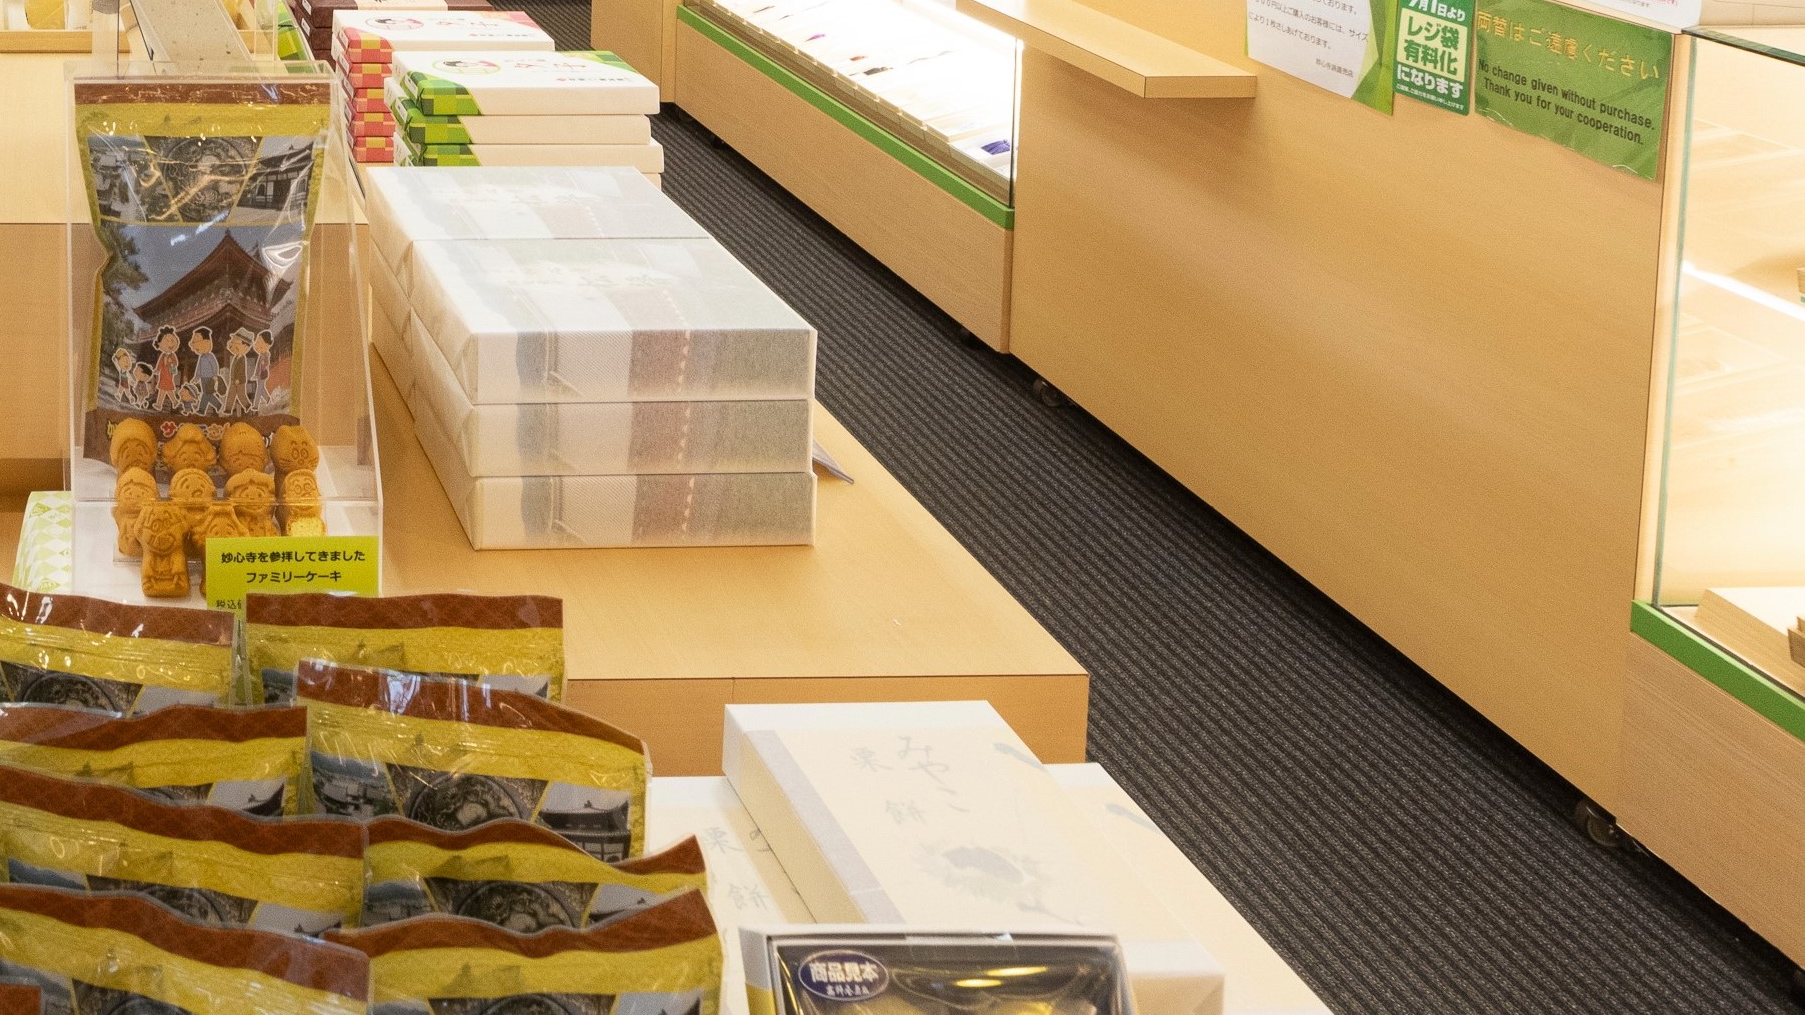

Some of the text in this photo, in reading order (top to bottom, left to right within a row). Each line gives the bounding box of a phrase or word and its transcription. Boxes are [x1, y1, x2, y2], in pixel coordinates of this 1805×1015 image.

[1407, 15, 1460, 51] レジ袋
[1477, 10, 1659, 80] 両替はご遠慮ください
[1403, 38, 1458, 76] 有料化
[1397, 64, 1463, 99] になります
[1479, 58, 1655, 130] No change given without purchase.
[1484, 77, 1644, 145] Thank you for your cooperation.
[221, 550, 366, 564] 妙心寺を参拝してきました
[246, 570, 342, 584] ファミリーケーキ
[808, 961, 879, 984] 商品見本
